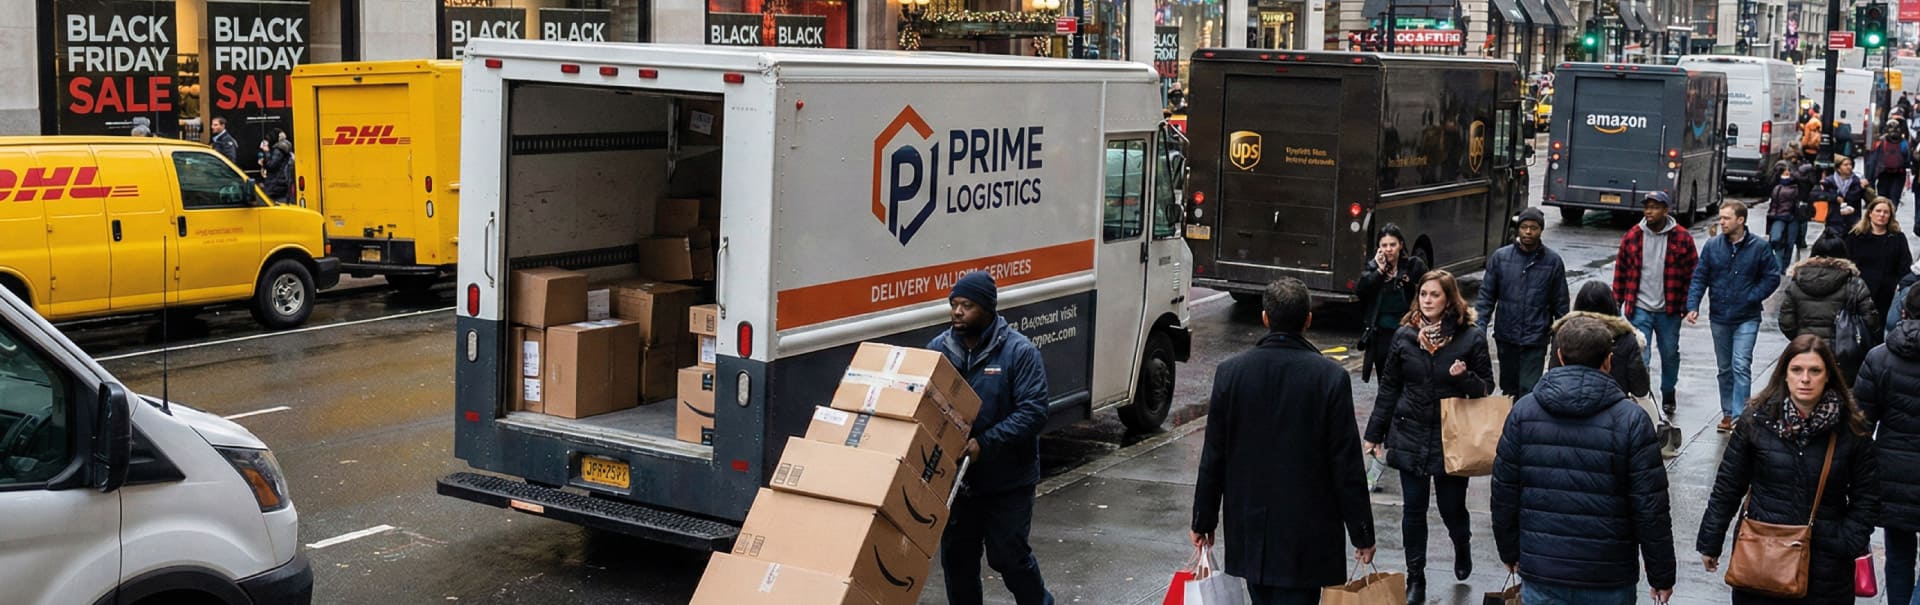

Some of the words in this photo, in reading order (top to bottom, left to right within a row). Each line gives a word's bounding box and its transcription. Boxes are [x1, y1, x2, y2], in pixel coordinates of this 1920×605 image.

[67, 14, 169, 42] BLACK
[215, 16, 304, 42] BLACK
[544, 22, 605, 42] BLACK
[711, 25, 759, 44] BLACK
[778, 26, 822, 44] BLACK
[1154, 33, 1177, 47] BLACK
[68, 46, 170, 72] FRIDAY
[215, 46, 304, 70] FRIDAY
[69, 76, 172, 114] SALE
[1586, 113, 1647, 128] amazon
[335, 125, 399, 145] DHL
[948, 126, 1044, 176] PRIME
[1232, 143, 1259, 164] ups
[947, 178, 1041, 214] LOGISTICS
[871, 276, 931, 303] DELIVERY
[1060, 304, 1078, 320] visit
